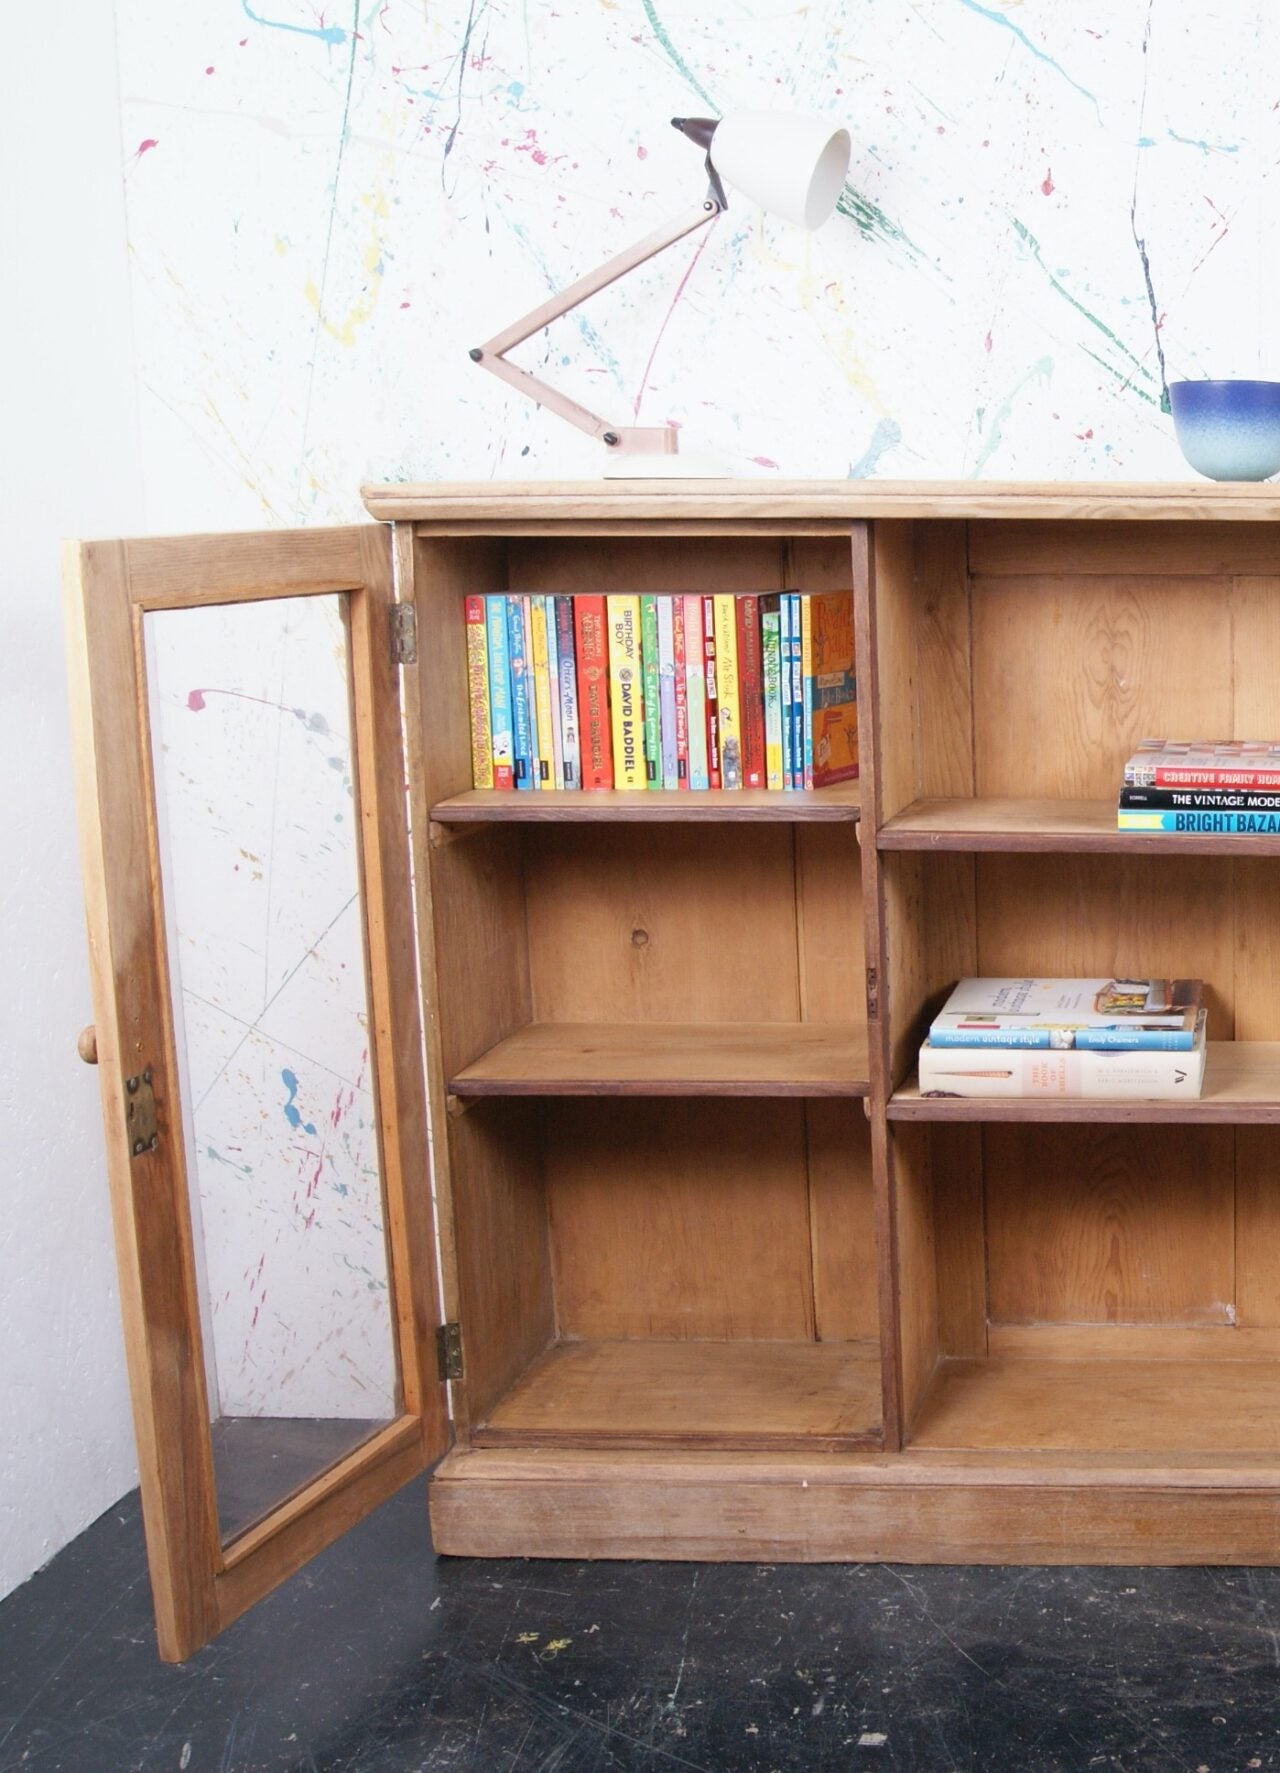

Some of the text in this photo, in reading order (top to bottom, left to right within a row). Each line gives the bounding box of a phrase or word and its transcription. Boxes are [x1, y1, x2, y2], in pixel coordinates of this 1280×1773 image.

[581, 612, 595, 660] AGENCY
[615, 623, 625, 646] BOY
[623, 610, 635, 660] BIRTHDAY
[562, 691, 575, 722] Moon
[621, 683, 636, 773] DAVID BADDIEL
[1163, 772, 1215, 784] CREATIVE
[1218, 773, 1255, 786] FAMILY
[1172, 794, 1192, 805] THE
[1194, 795, 1245, 806] VINTAGE
[1175, 813, 1234, 832] BRIGHT
[945, 1033, 1041, 1045] modern vintage style
[1088, 1036, 1139, 1044] Emily Chalmers
